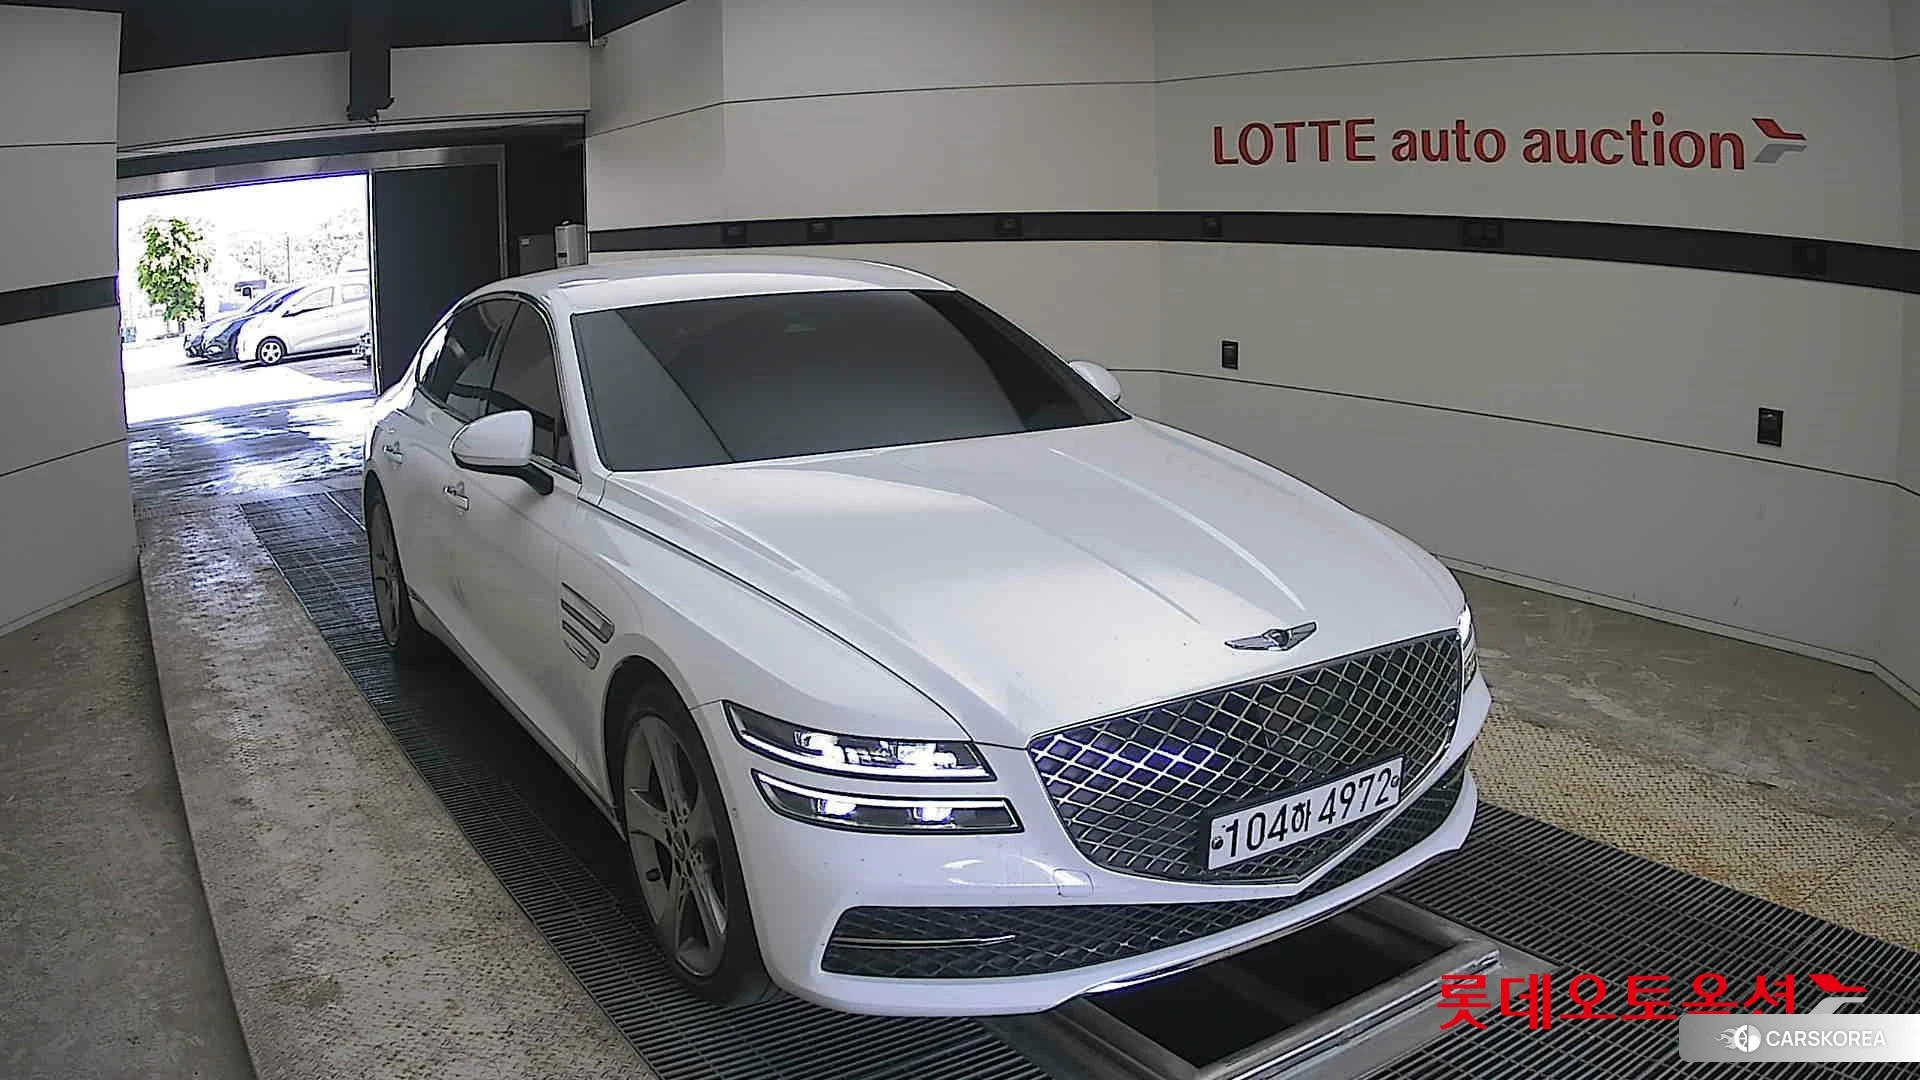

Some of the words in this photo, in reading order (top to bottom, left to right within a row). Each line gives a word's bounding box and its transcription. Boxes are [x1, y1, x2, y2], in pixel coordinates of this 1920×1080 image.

[1212, 118, 1377, 166] LOTTE
[1391, 119, 1507, 163] auto
[1522, 111, 1746, 170] auction
[1224, 799, 1312, 858] 104하
[1318, 767, 1393, 825] 4972
